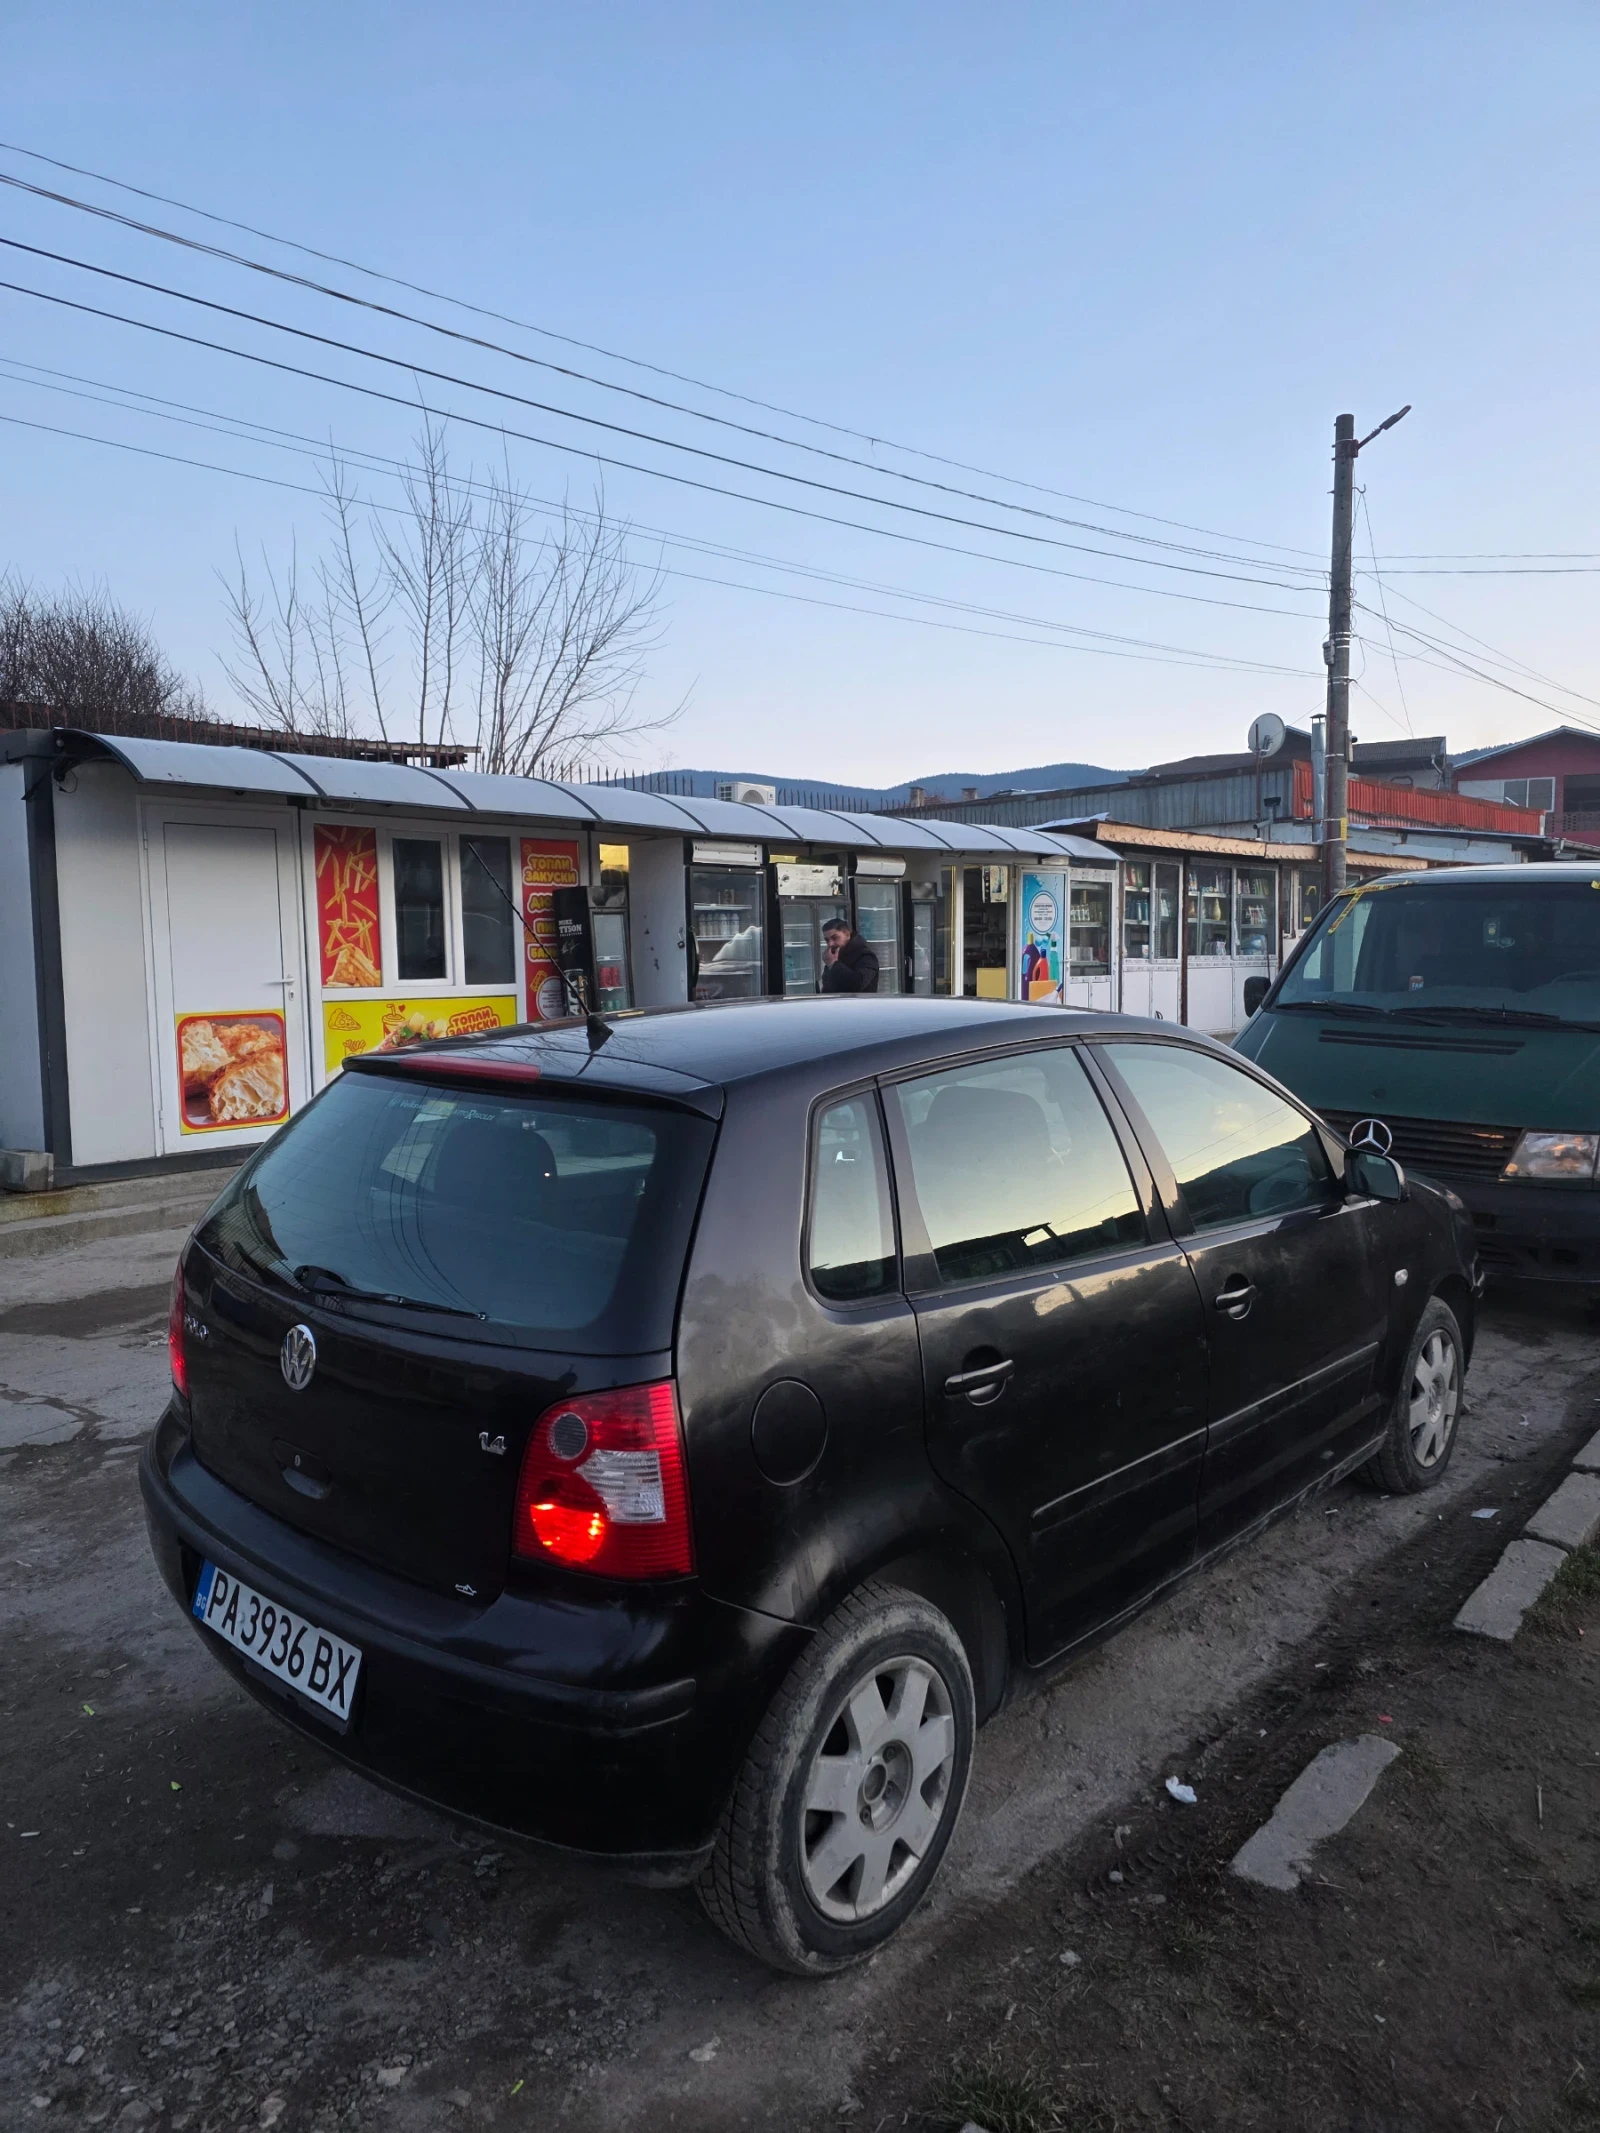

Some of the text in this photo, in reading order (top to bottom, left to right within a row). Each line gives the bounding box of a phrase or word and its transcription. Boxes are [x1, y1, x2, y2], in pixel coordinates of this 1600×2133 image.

[530, 858, 570, 870] ТОПЛИ
[525, 870, 576, 883] ЗАКУСКИ
[530, 895, 553, 910] ДЮ
[536, 921, 556, 934] ПИ
[559, 924, 582, 934] TYSON
[452, 1009, 490, 1028] ТОПЛИ
[448, 1017, 498, 1036] ЗАКУСКИ
[196, 1592, 207, 1611] BG
[240, 1595, 309, 1678] 3936
